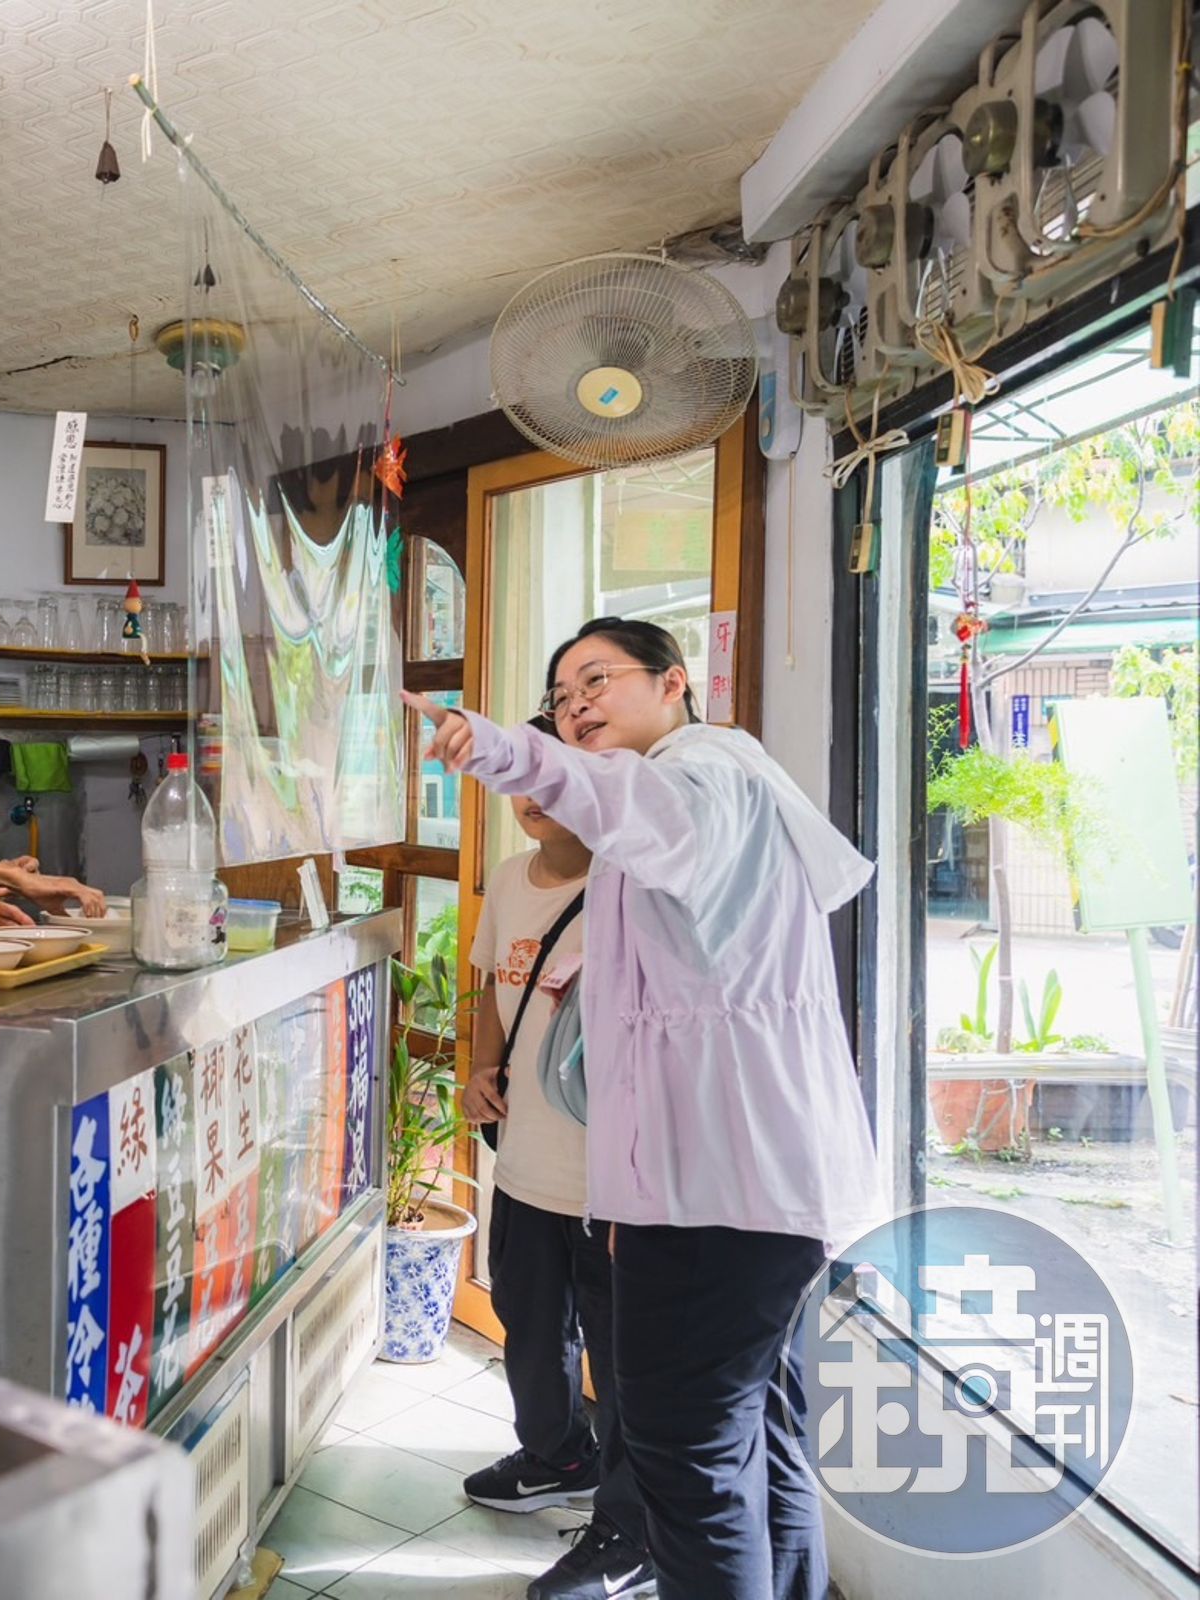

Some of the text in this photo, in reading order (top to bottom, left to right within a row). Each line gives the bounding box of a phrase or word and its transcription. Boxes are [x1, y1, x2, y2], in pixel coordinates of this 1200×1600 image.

[348, 970, 373, 1032] 368
[66, 1115, 106, 1410] 各種冷
